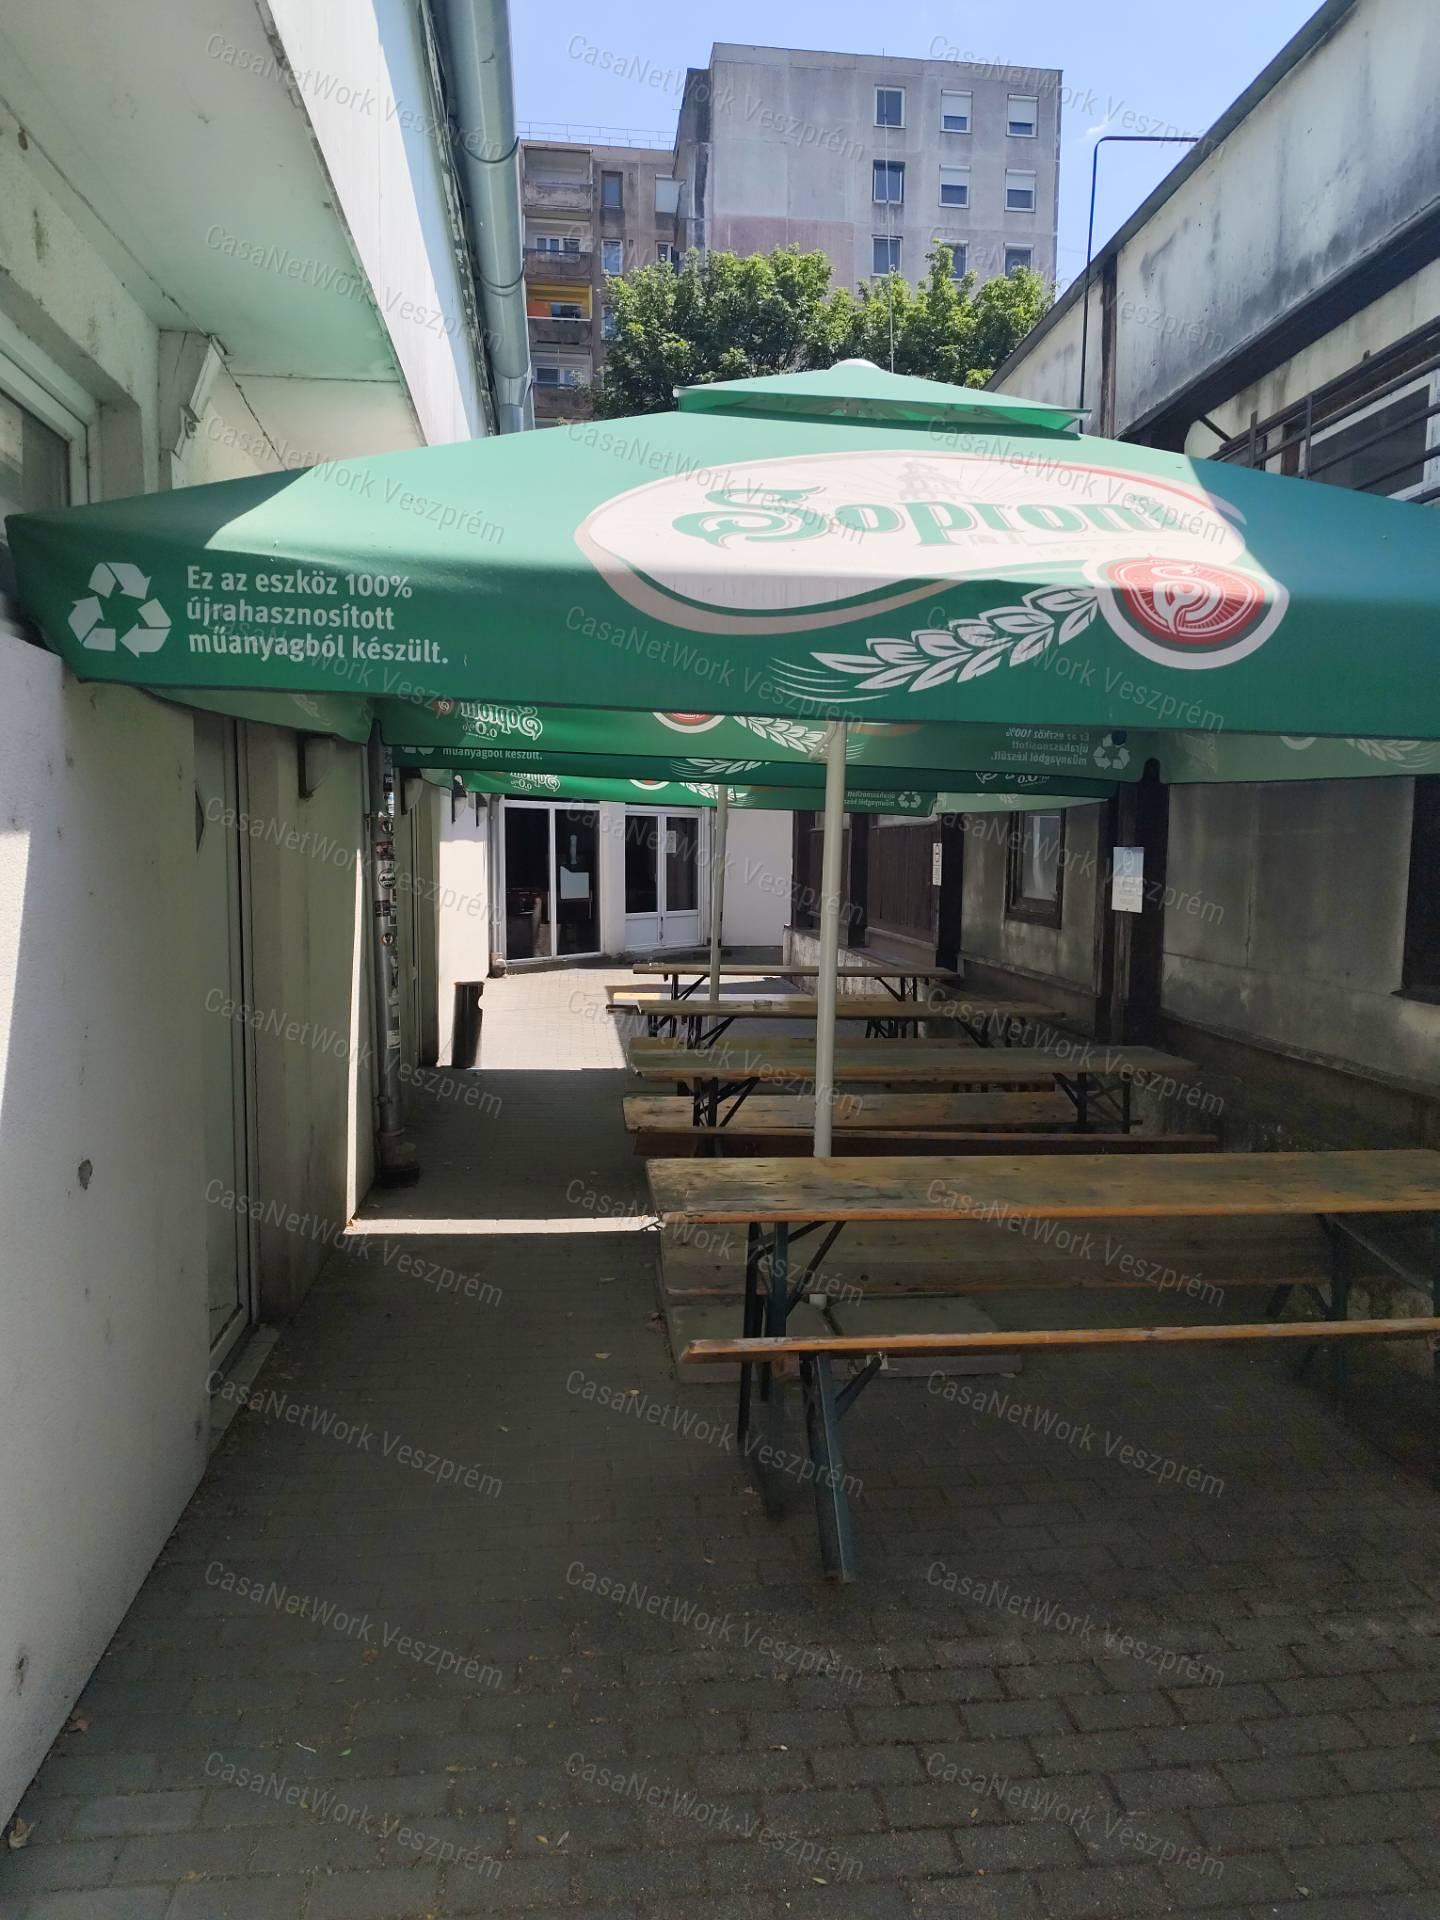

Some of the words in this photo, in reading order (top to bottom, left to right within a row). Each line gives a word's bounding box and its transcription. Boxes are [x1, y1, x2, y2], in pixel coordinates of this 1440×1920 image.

[187, 565, 213, 590] Ez
[221, 572, 247, 592] az
[255, 569, 338, 595] eszköz
[345, 573, 412, 598] 100%
[186, 597, 395, 630] újrahasznosított
[188, 626, 345, 662] műanyagból
[352, 635, 449, 664] készült.
